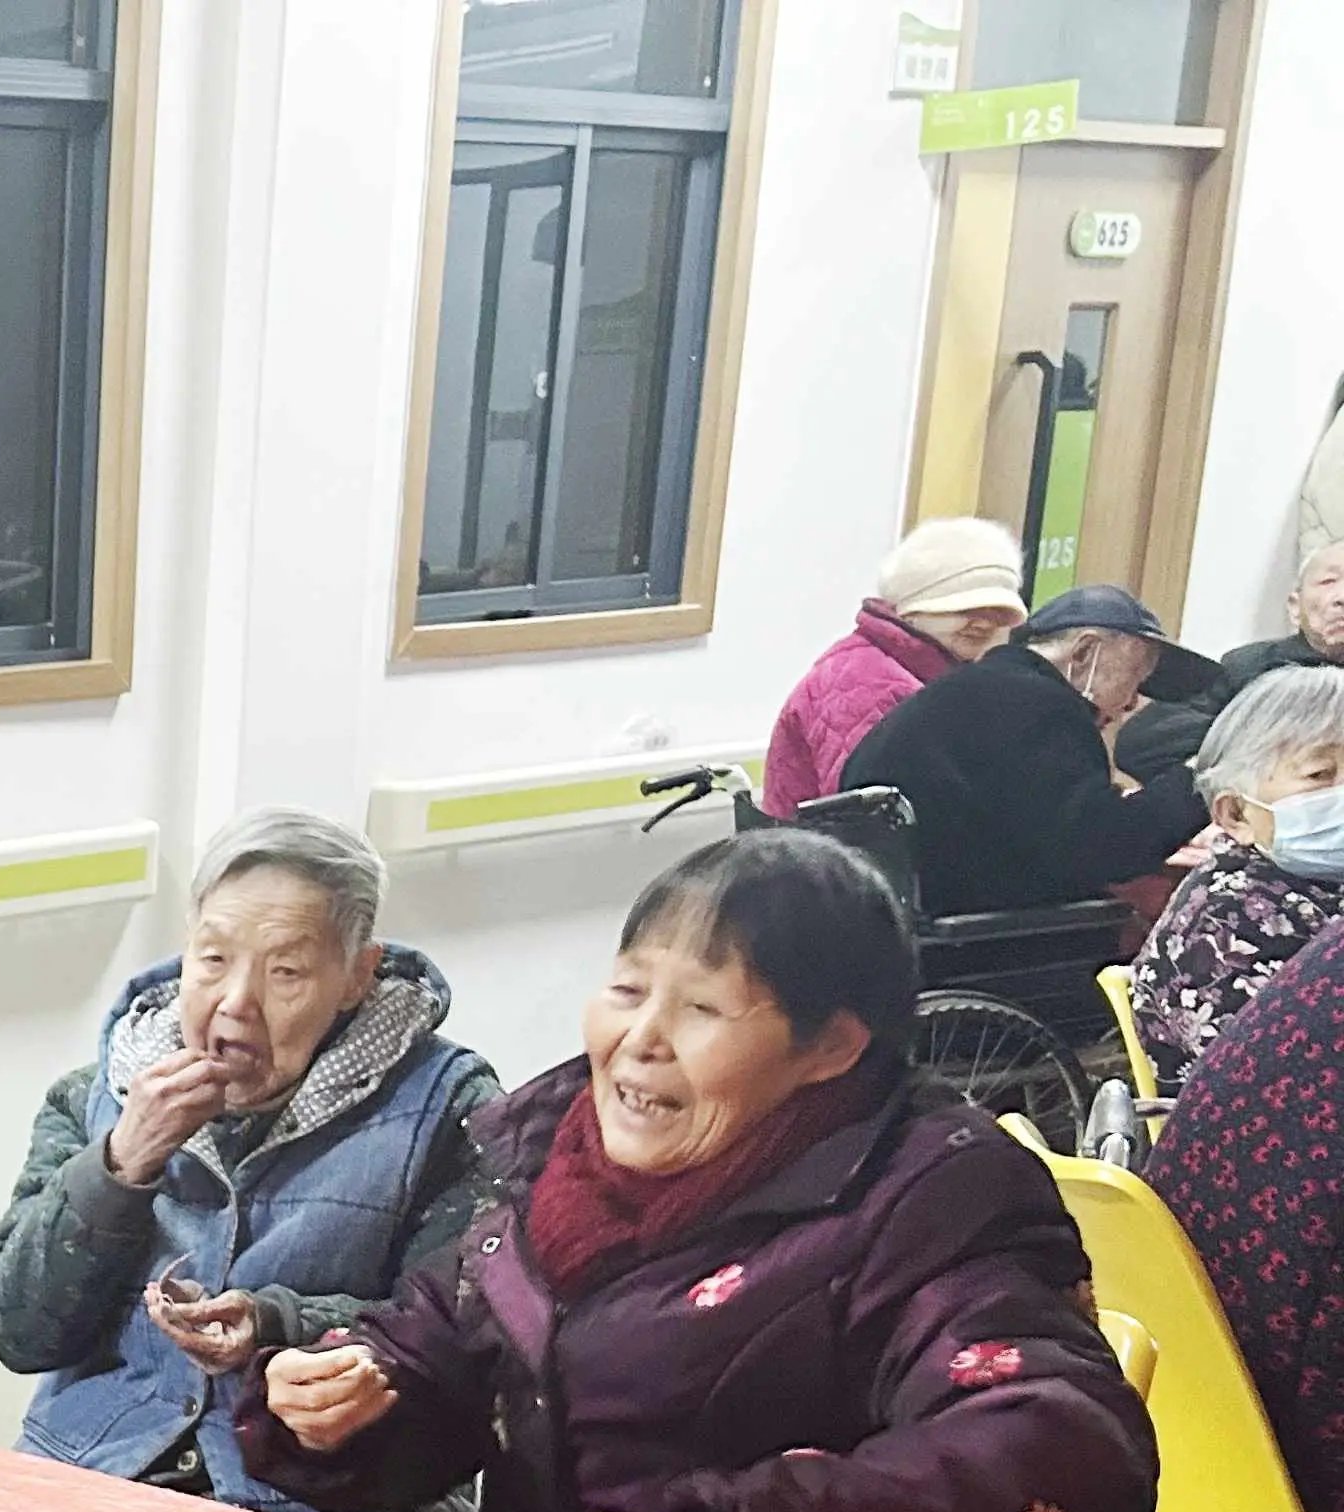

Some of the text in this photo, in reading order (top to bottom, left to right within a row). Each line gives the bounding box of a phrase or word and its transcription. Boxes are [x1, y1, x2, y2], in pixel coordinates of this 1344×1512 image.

[1005, 103, 1065, 140] 125
[1097, 219, 1129, 247] 625
[1038, 535, 1075, 569] 125
